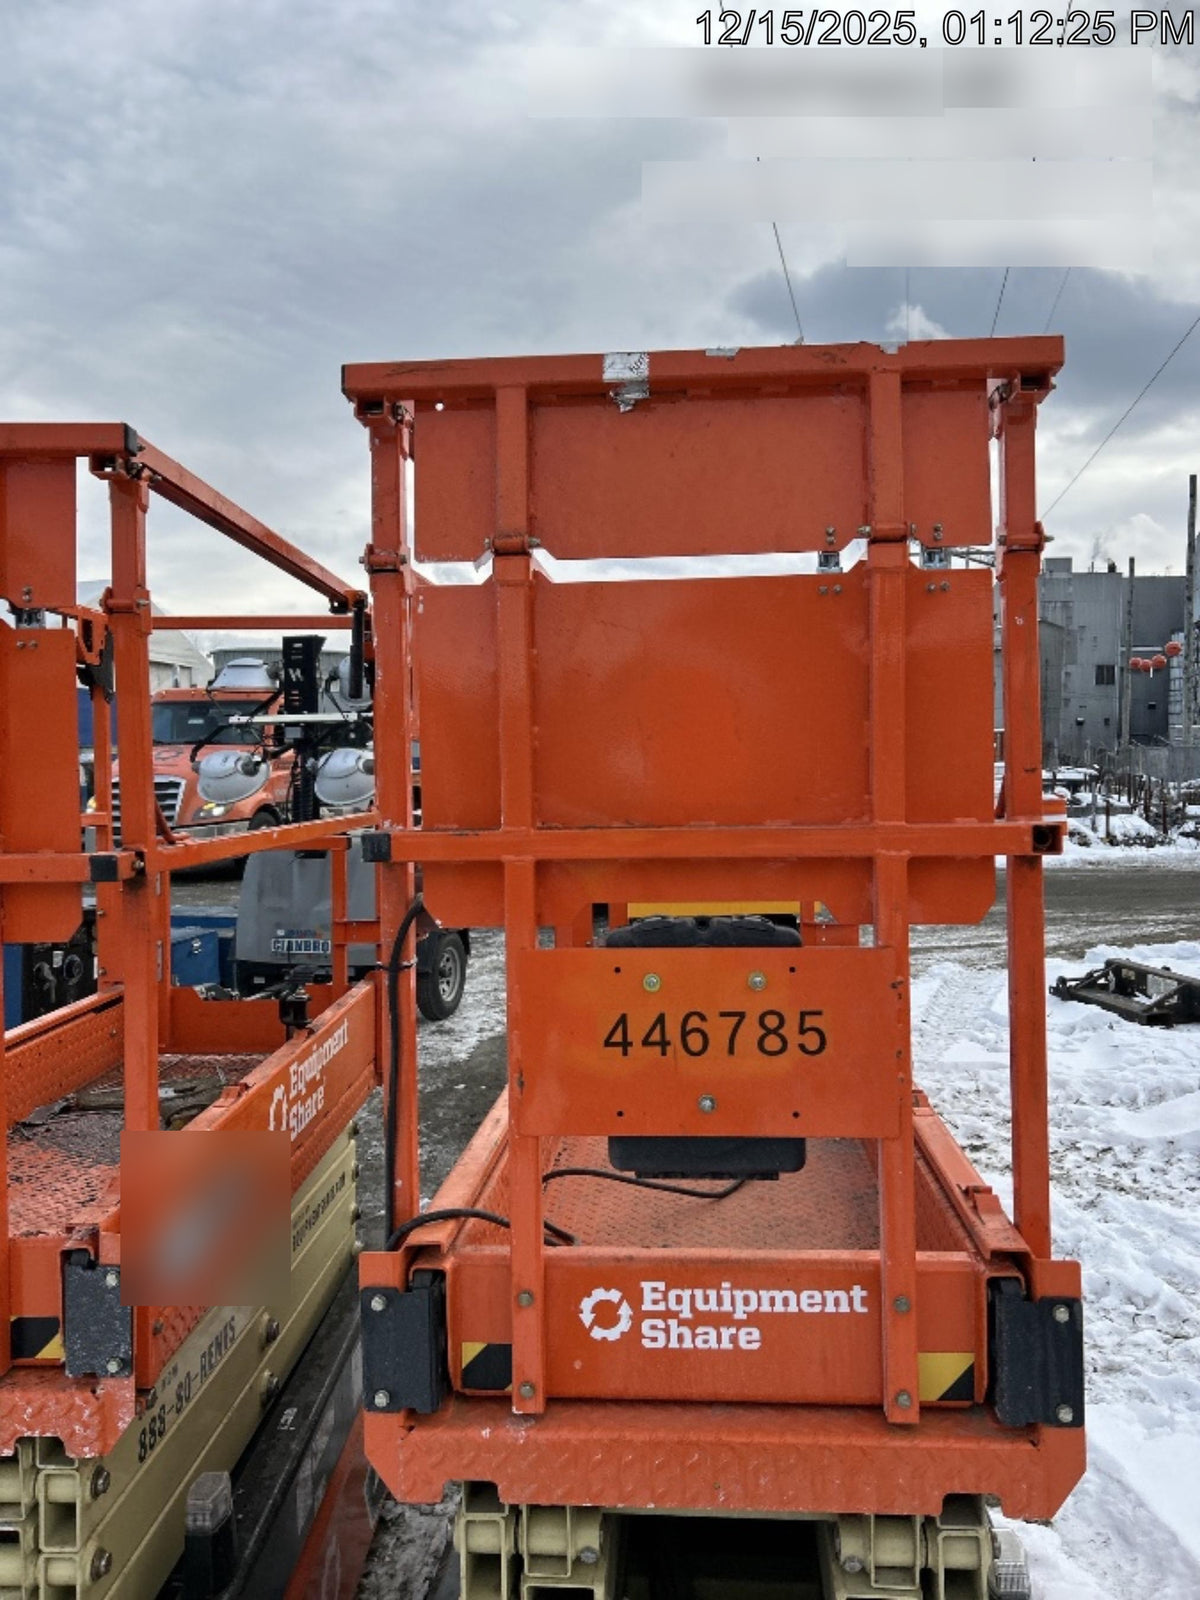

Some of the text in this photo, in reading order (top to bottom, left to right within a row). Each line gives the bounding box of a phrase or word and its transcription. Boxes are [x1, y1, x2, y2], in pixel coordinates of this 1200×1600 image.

[604, 1009, 827, 1057] 446785
[289, 1018, 348, 1101] Equipment
[289, 1086, 325, 1142] Share
[640, 1281, 867, 1319] Equipment
[641, 1318, 761, 1350] Share
